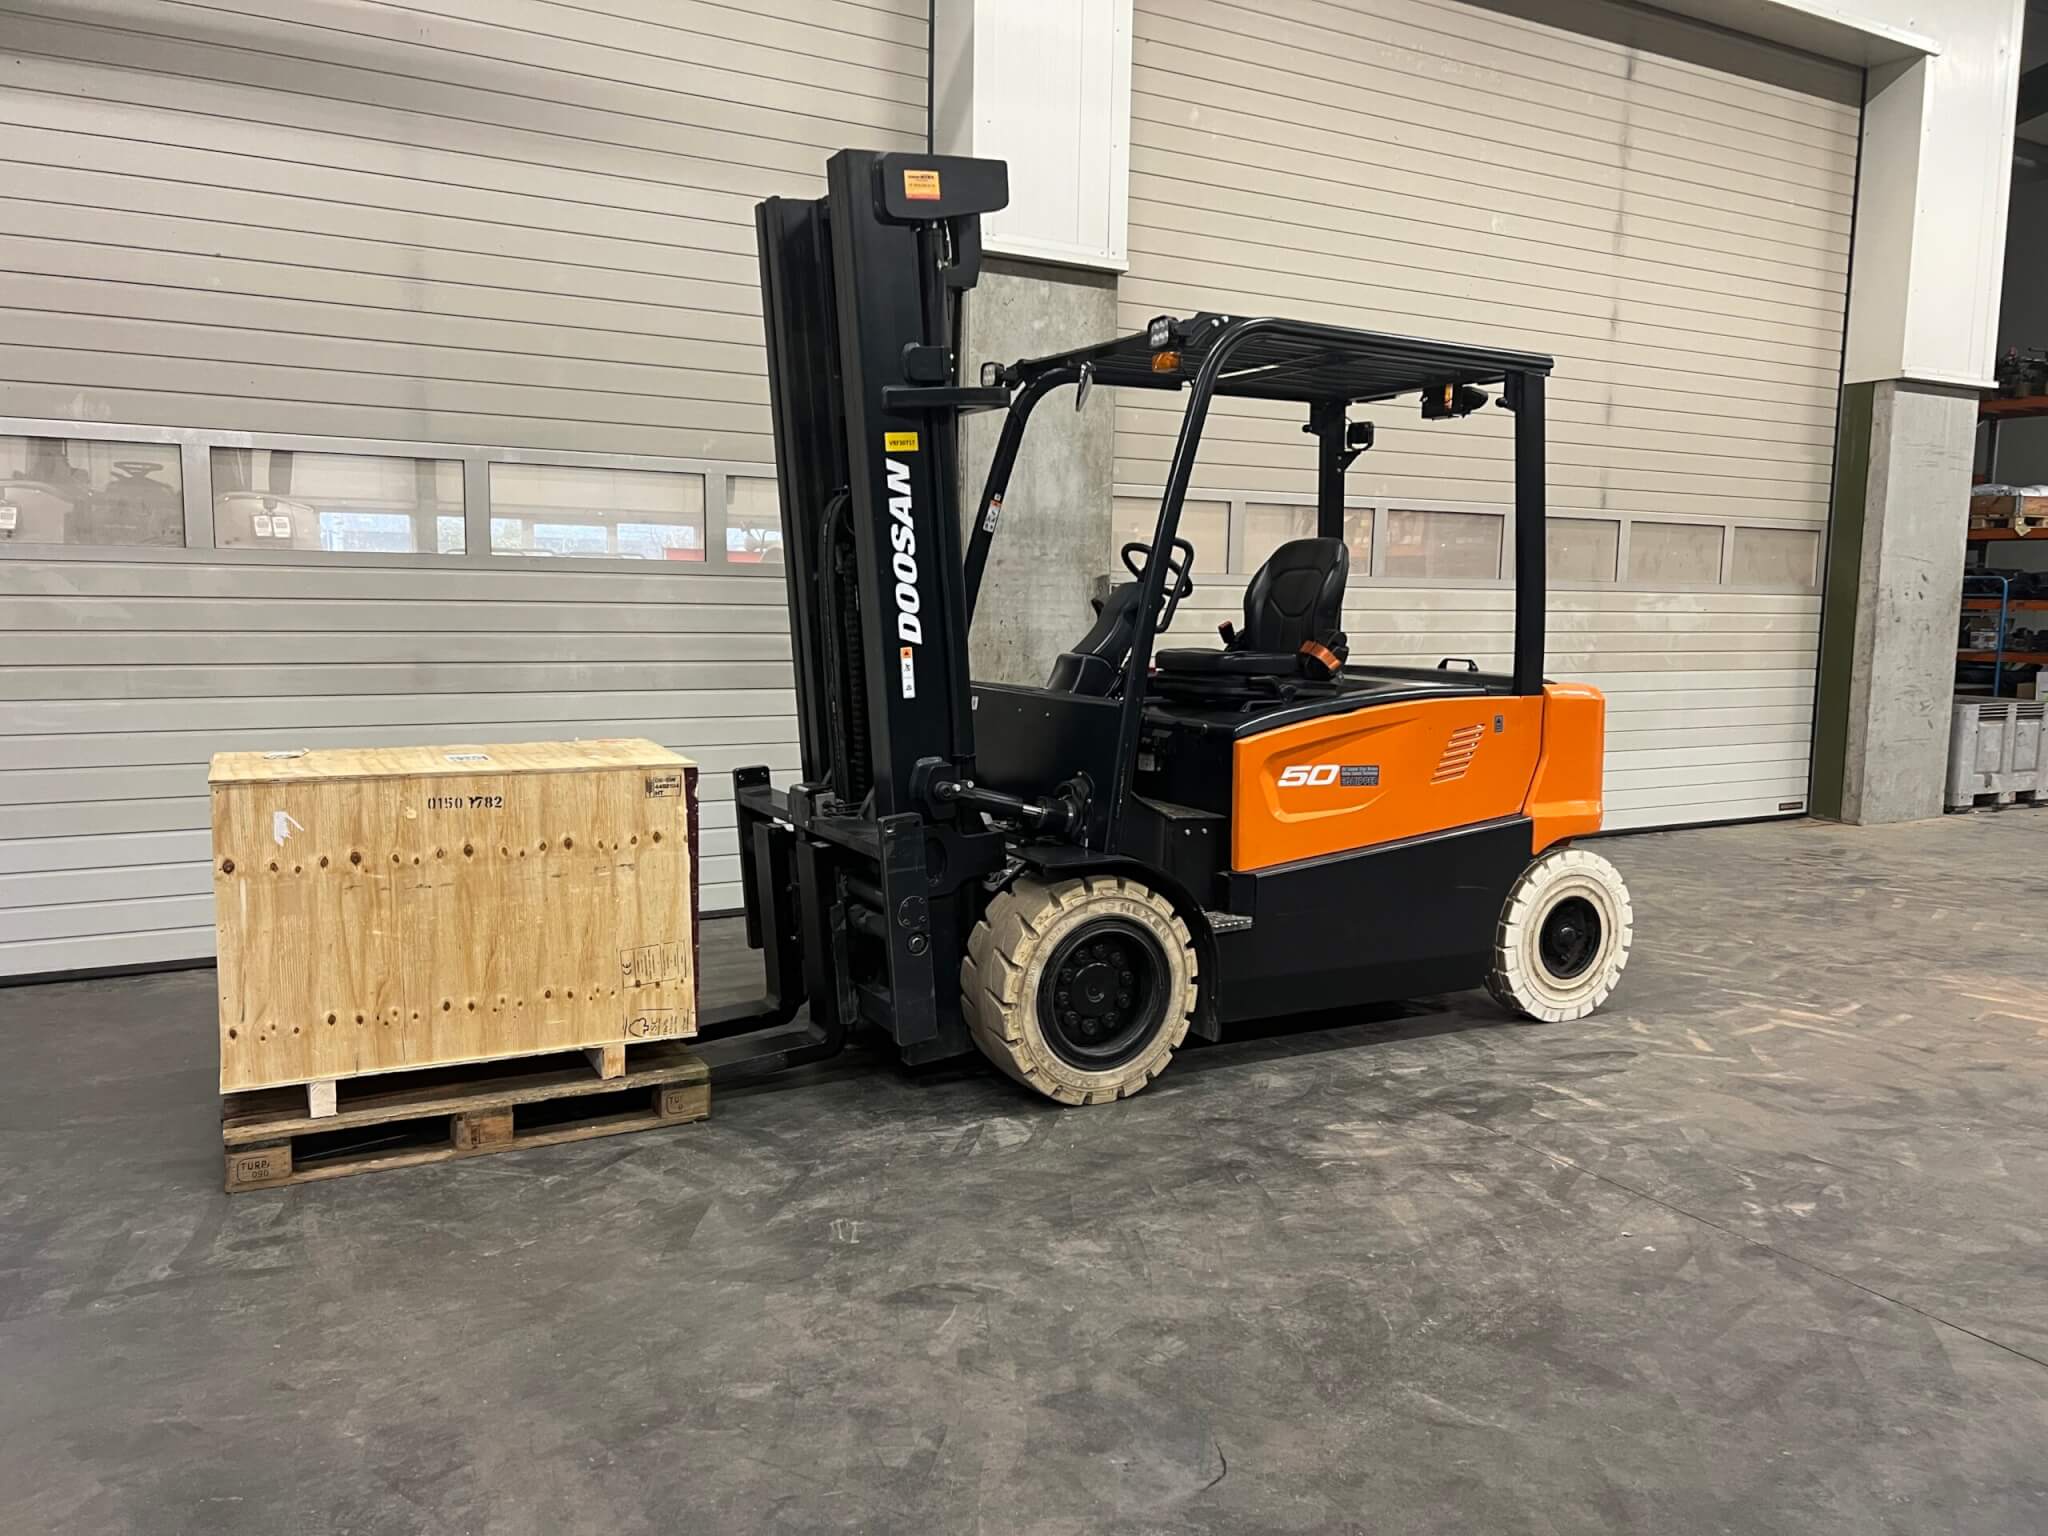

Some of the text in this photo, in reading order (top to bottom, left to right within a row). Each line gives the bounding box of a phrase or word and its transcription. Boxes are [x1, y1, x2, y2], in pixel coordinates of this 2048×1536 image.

[886, 458, 922, 645] DOOSAN
[1277, 764, 1340, 787] 50
[428, 796, 463, 810] 0150
